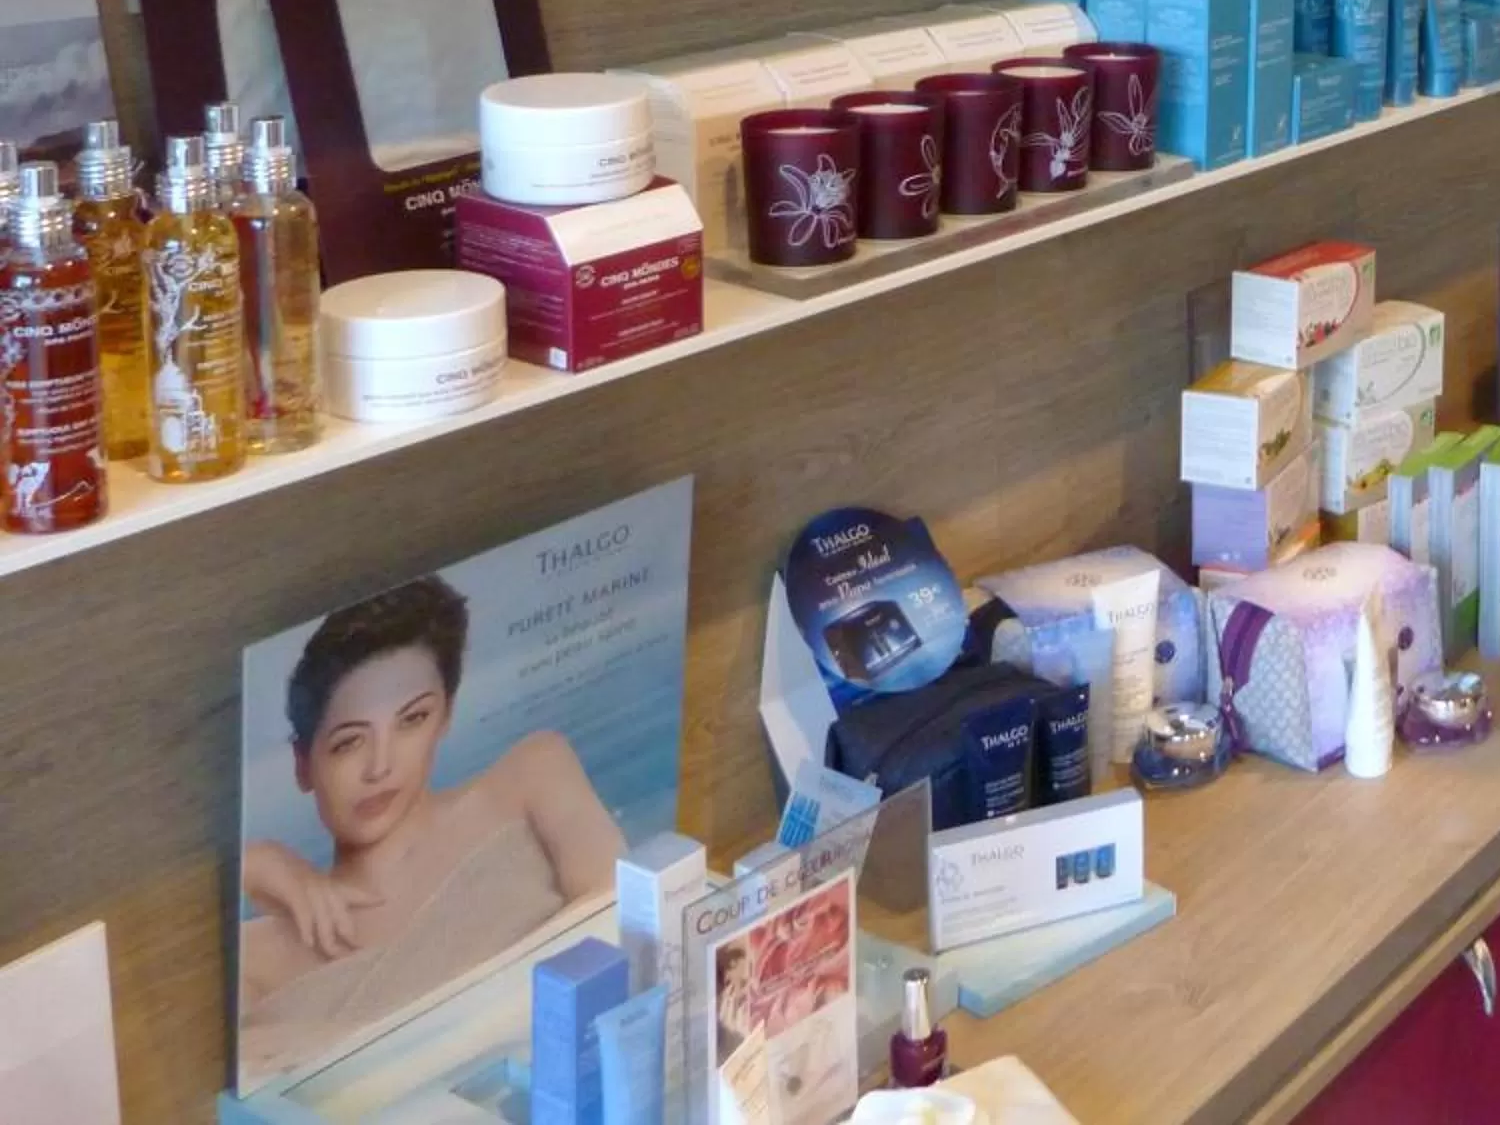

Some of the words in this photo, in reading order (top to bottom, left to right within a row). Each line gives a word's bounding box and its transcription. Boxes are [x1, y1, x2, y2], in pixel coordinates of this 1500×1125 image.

[405, 189, 446, 211] CINQ
[13, 325, 54, 338] CINQ
[535, 523, 632, 575] THALGO
[811, 523, 870, 554] THALGO
[980, 724, 1029, 751] THALGO
[971, 843, 1025, 867] THALGO
[695, 893, 751, 935] COUP
[756, 881, 778, 904] DE
